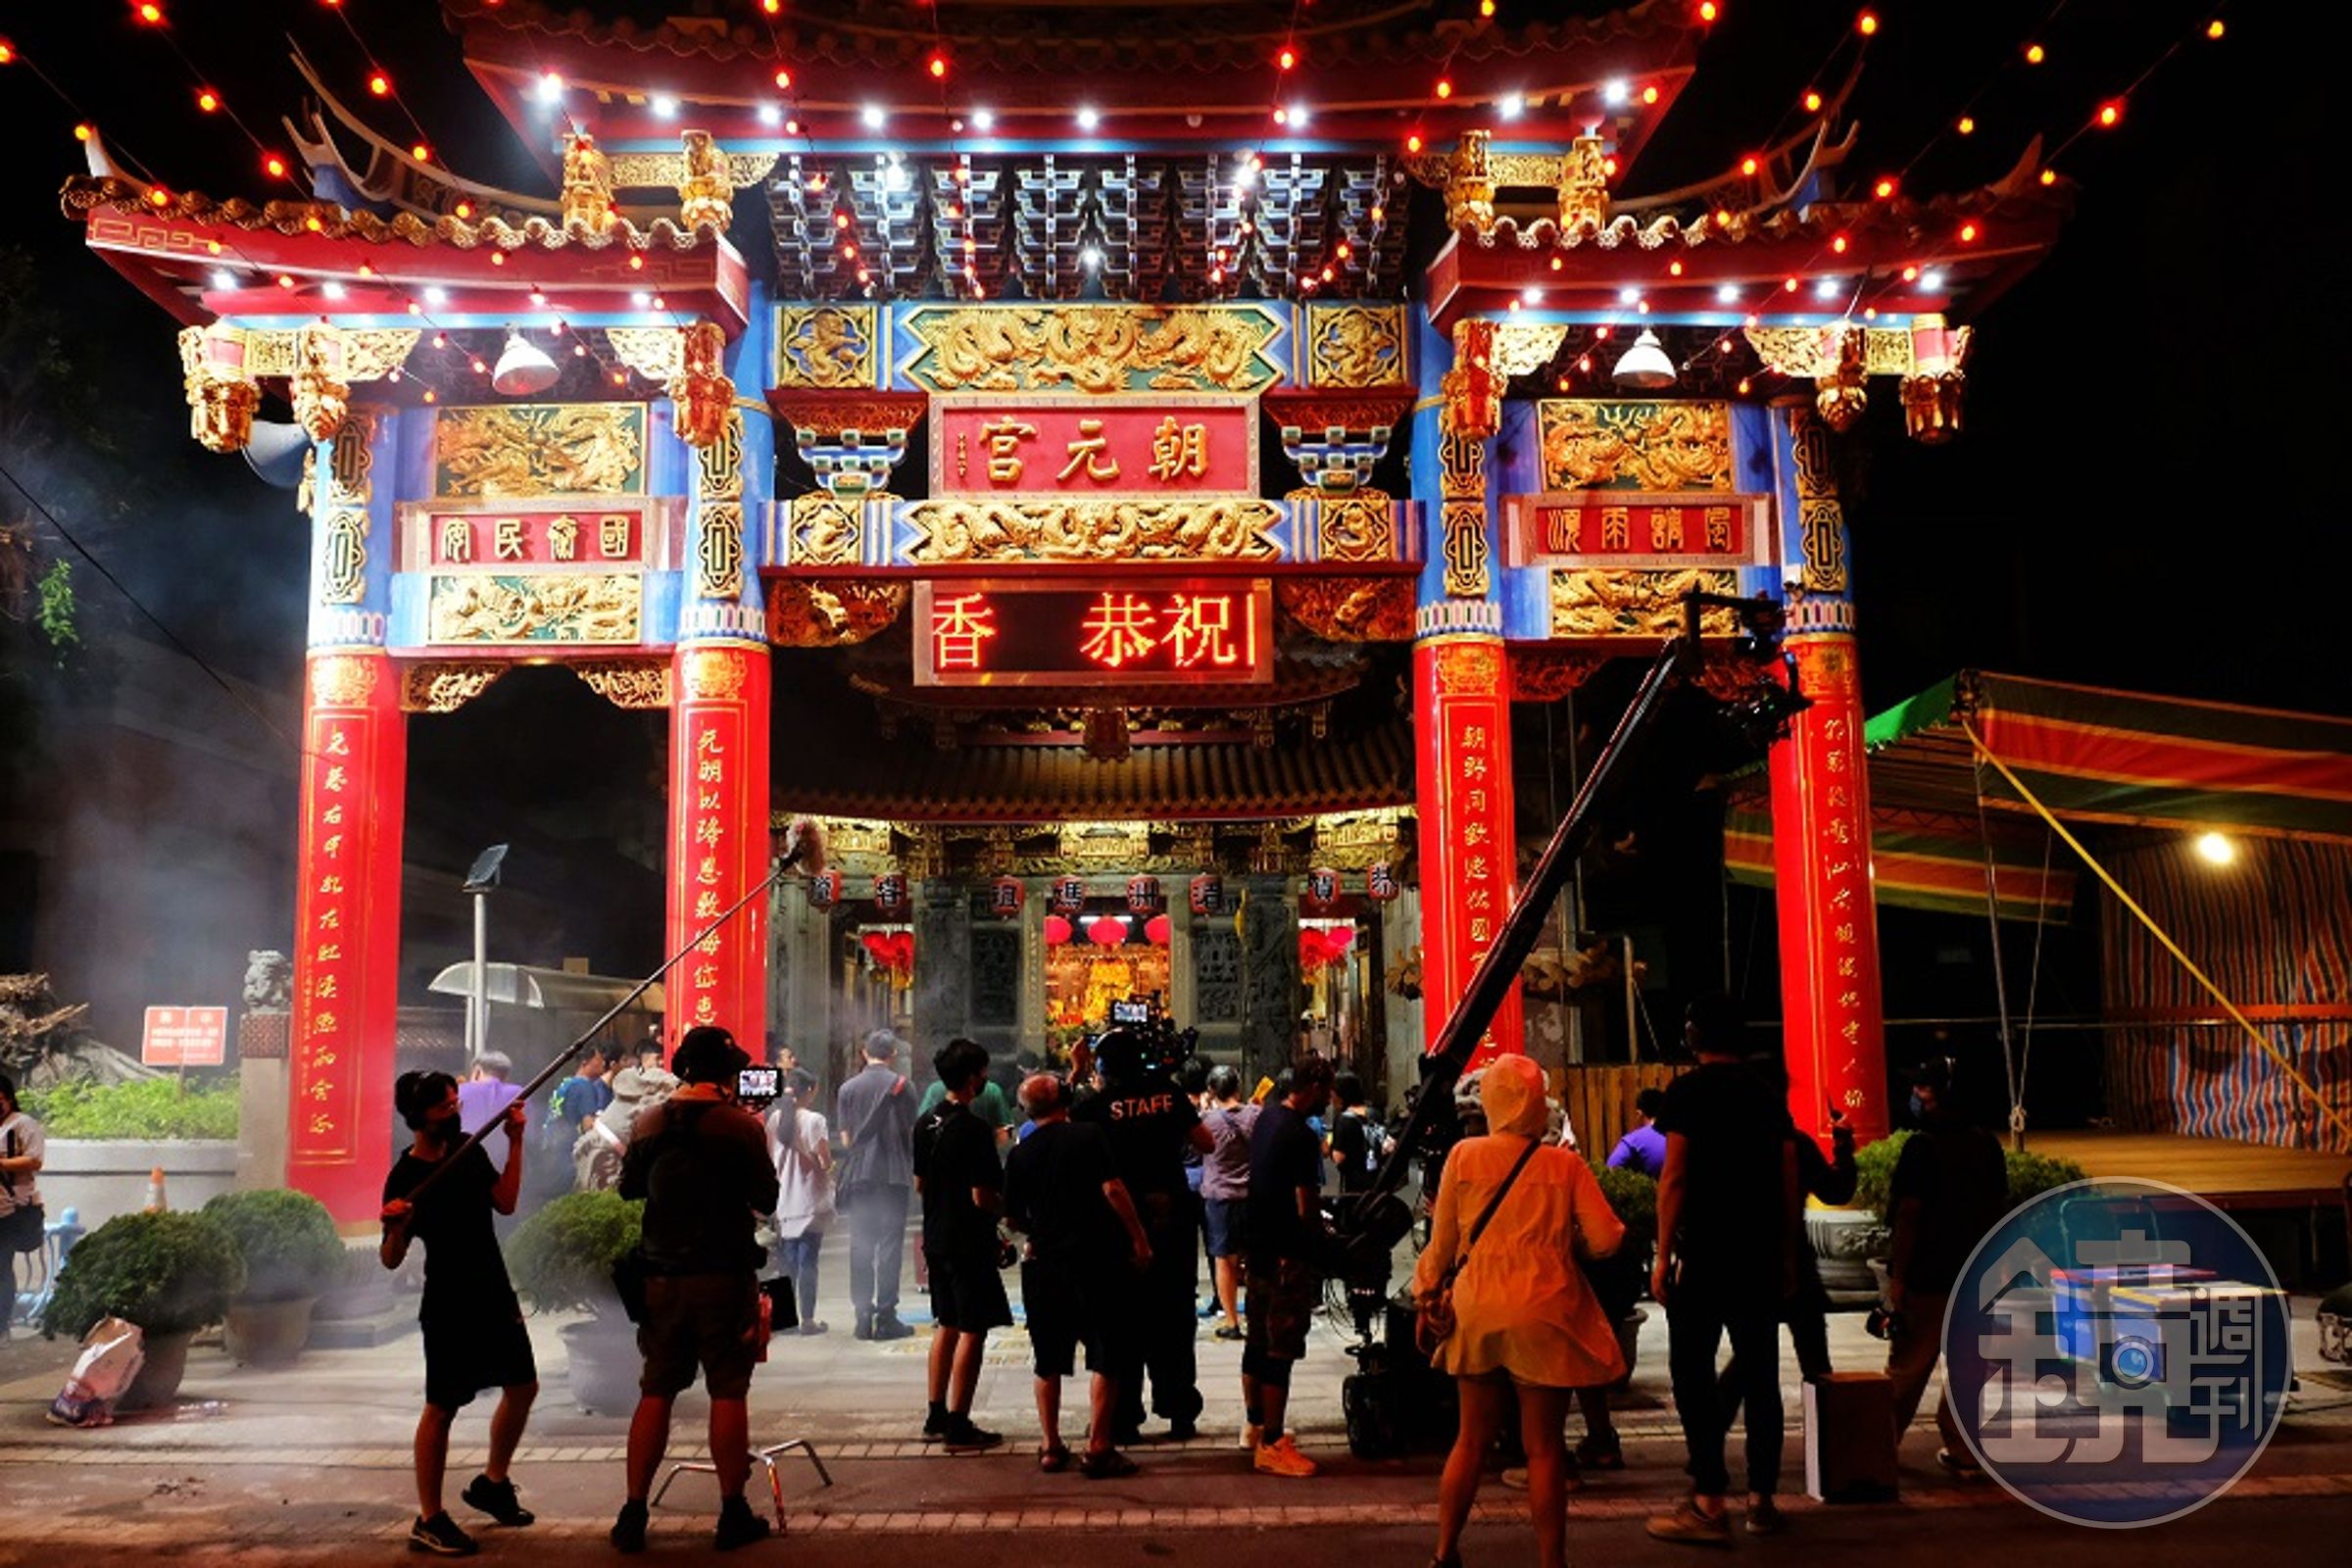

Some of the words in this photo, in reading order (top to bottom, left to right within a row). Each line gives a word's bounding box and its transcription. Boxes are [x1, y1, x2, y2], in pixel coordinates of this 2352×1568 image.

[979, 415, 1209, 482] 朝元宮
[932, 592, 994, 669] 香
[1110, 1094, 1173, 1120] STAFF
